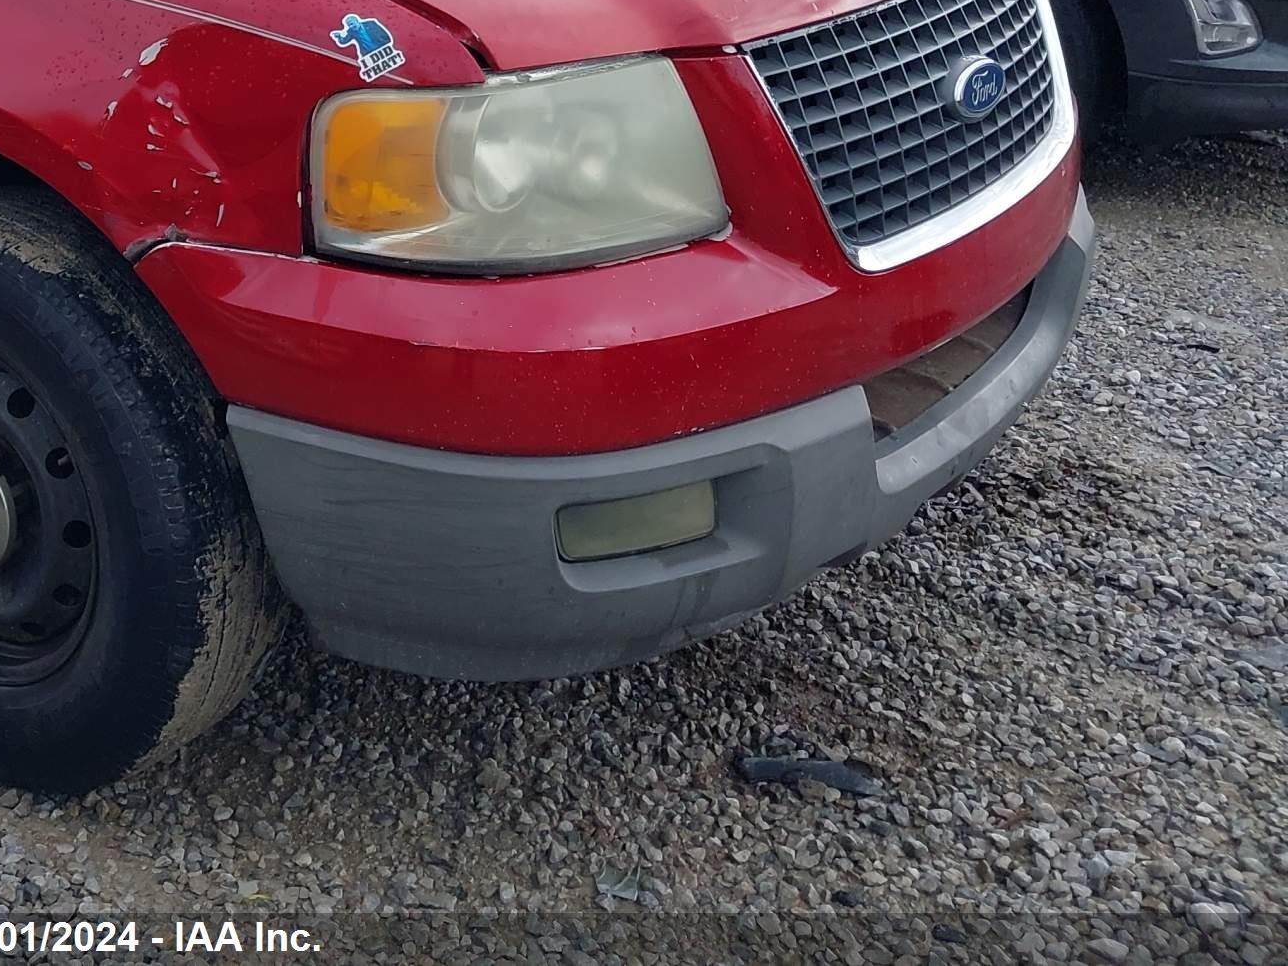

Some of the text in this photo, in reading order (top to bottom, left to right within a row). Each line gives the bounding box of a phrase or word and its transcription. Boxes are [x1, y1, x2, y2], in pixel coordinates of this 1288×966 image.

[362, 52, 404, 80] THAT!
[370, 45, 393, 65] DID
[971, 70, 998, 106] Ford
